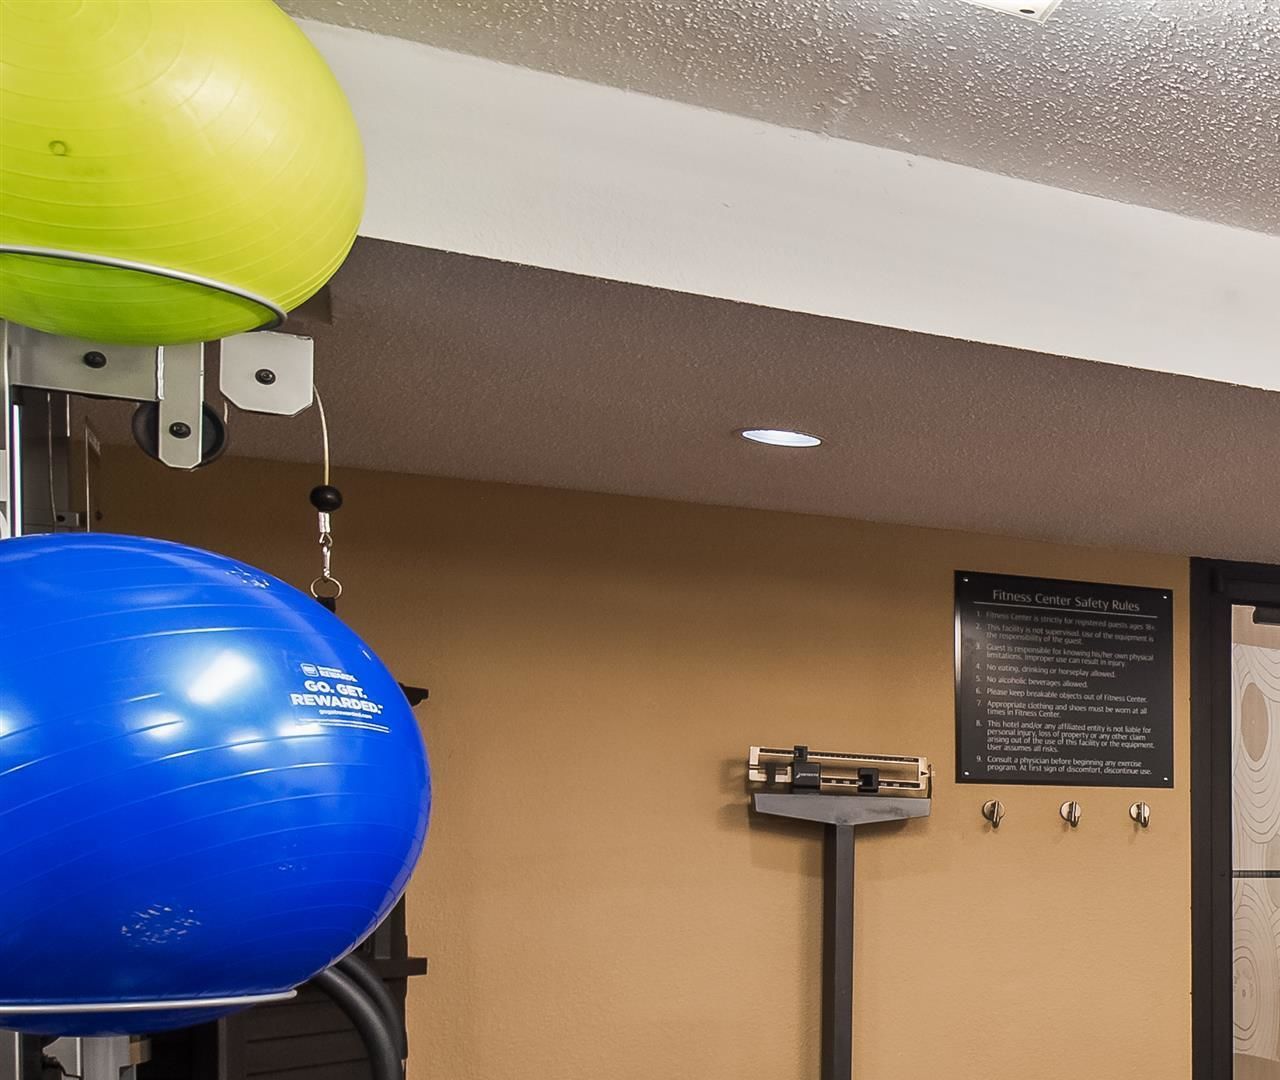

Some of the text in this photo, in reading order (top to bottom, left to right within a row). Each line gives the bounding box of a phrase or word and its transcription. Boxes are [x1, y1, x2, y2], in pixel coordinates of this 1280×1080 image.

[992, 588, 1140, 612] Fitness Center Safety Rules
[1014, 645, 1050, 655] responsible
[1063, 648, 1089, 657] knowing
[1092, 650, 1112, 659] his/her
[1129, 653, 1153, 662] physical
[1024, 653, 1053, 663] Improper
[1022, 666, 1047, 674] drinking
[1058, 668, 1088, 677] horseplay
[1028, 678, 1060, 687] beverages
[1009, 689, 1024, 697] keep
[1059, 692, 1081, 700] objects
[986, 700, 1025, 709] Appropriate
[1028, 702, 1052, 711] clothing
[1021, 722, 1041, 730] and/or
[986, 728, 1015, 736] personal
[1061, 731, 1088, 739] property
[986, 736, 1008, 744] arising
[1079, 739, 1098, 747] facility
[1020, 757, 1048, 765] physician
[1073, 759, 1102, 767] beginning
[1043, 765, 1056, 773] sign
